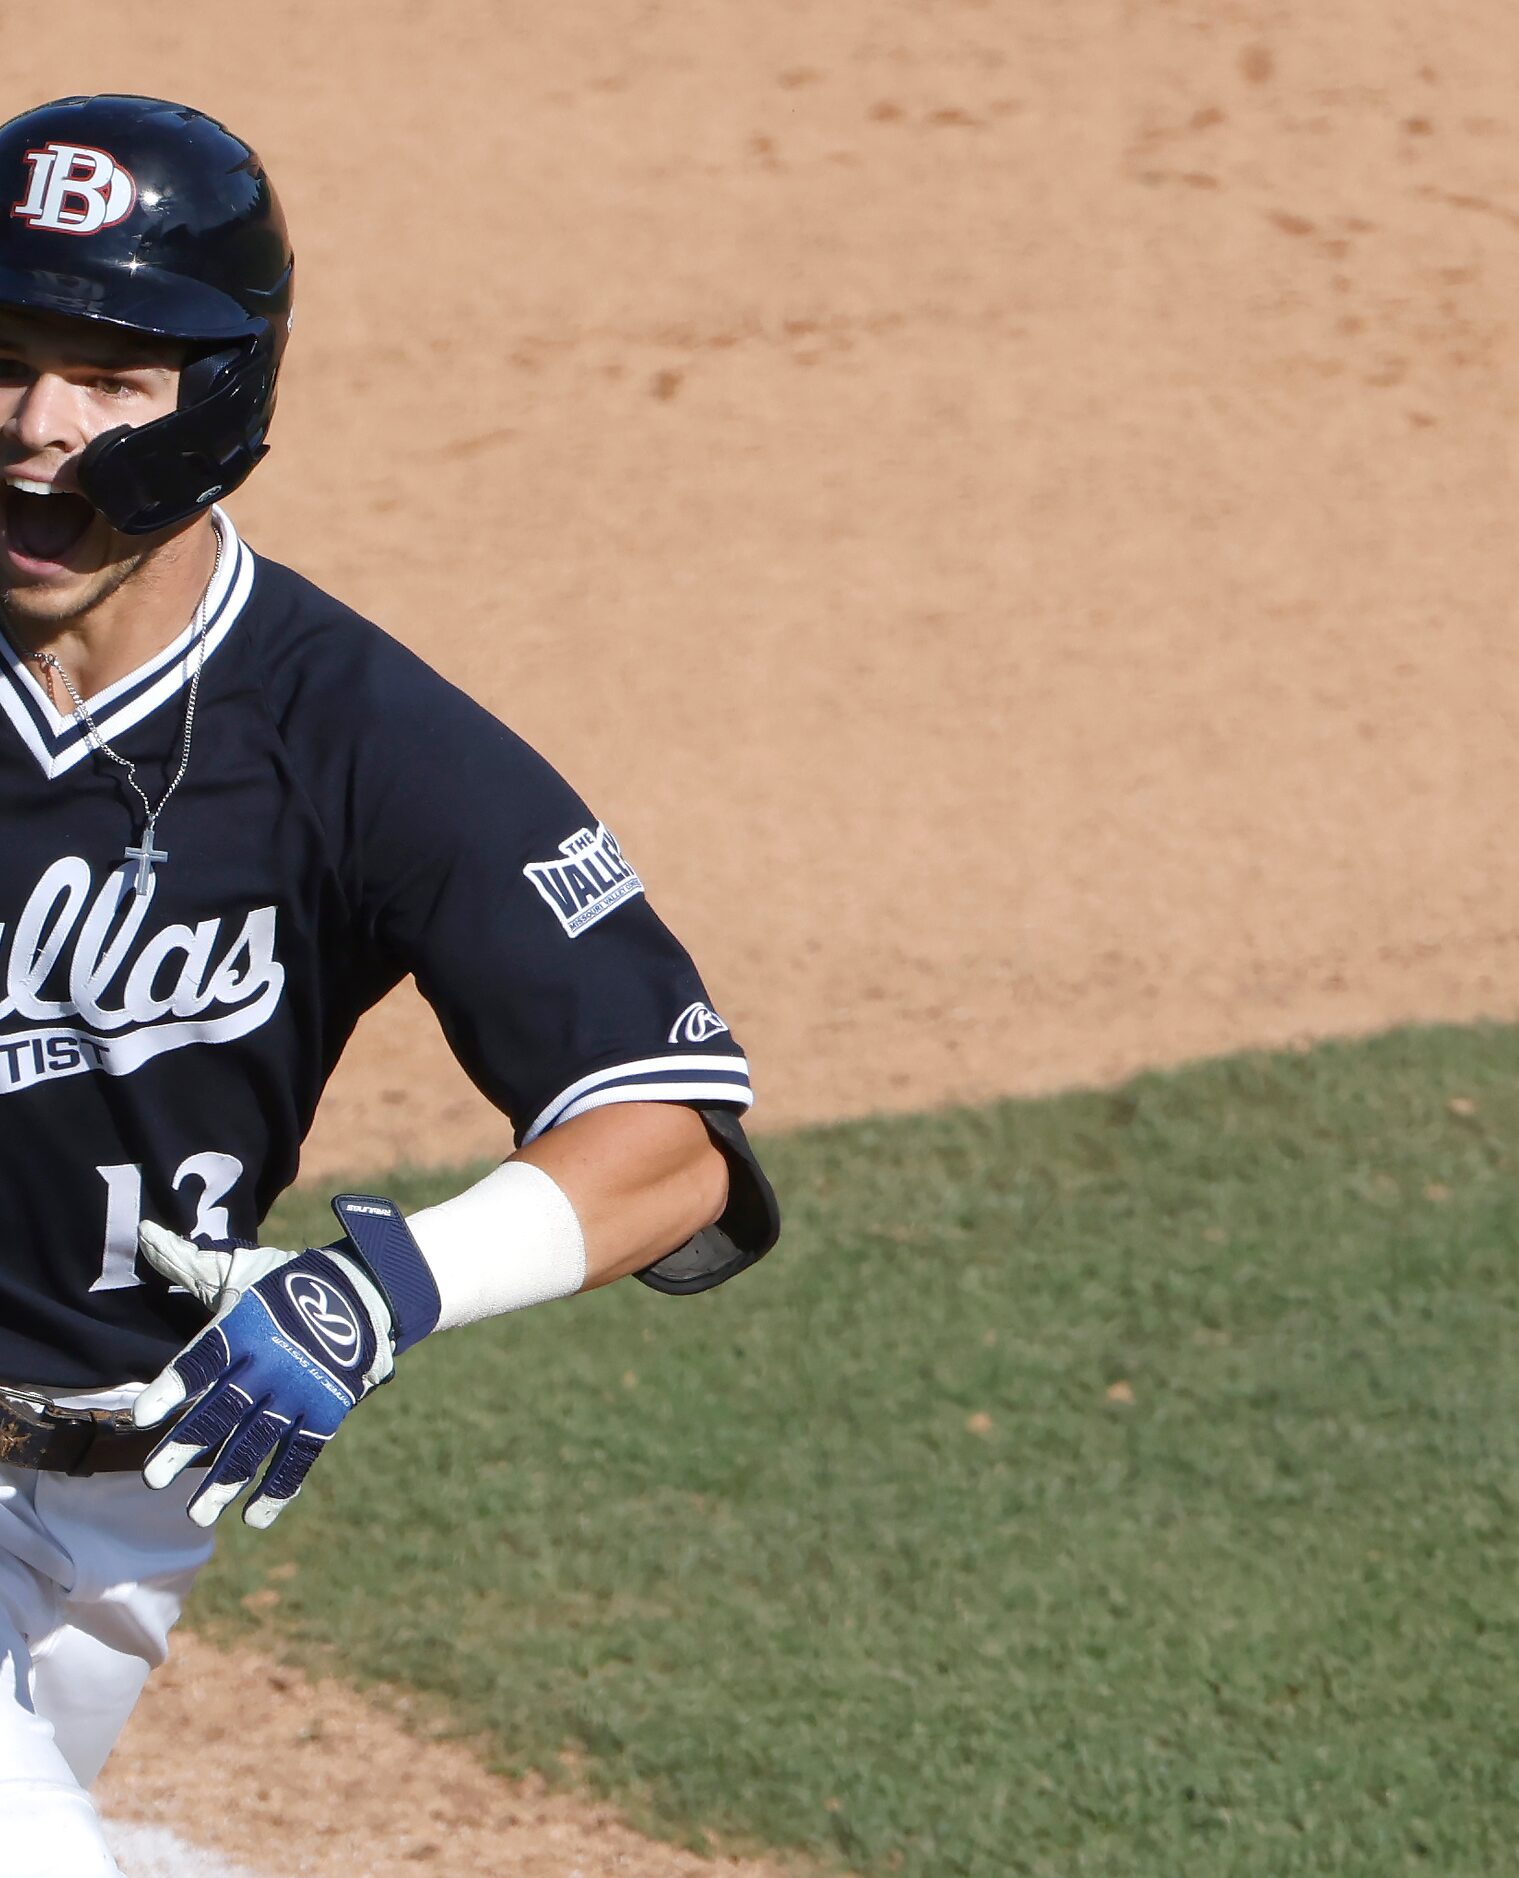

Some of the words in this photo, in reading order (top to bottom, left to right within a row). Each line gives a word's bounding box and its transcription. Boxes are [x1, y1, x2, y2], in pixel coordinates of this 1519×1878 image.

[565, 832, 595, 855] THE
[569, 903, 603, 930] MISSOURI
[271, 1336, 310, 1368] SYSTEM
